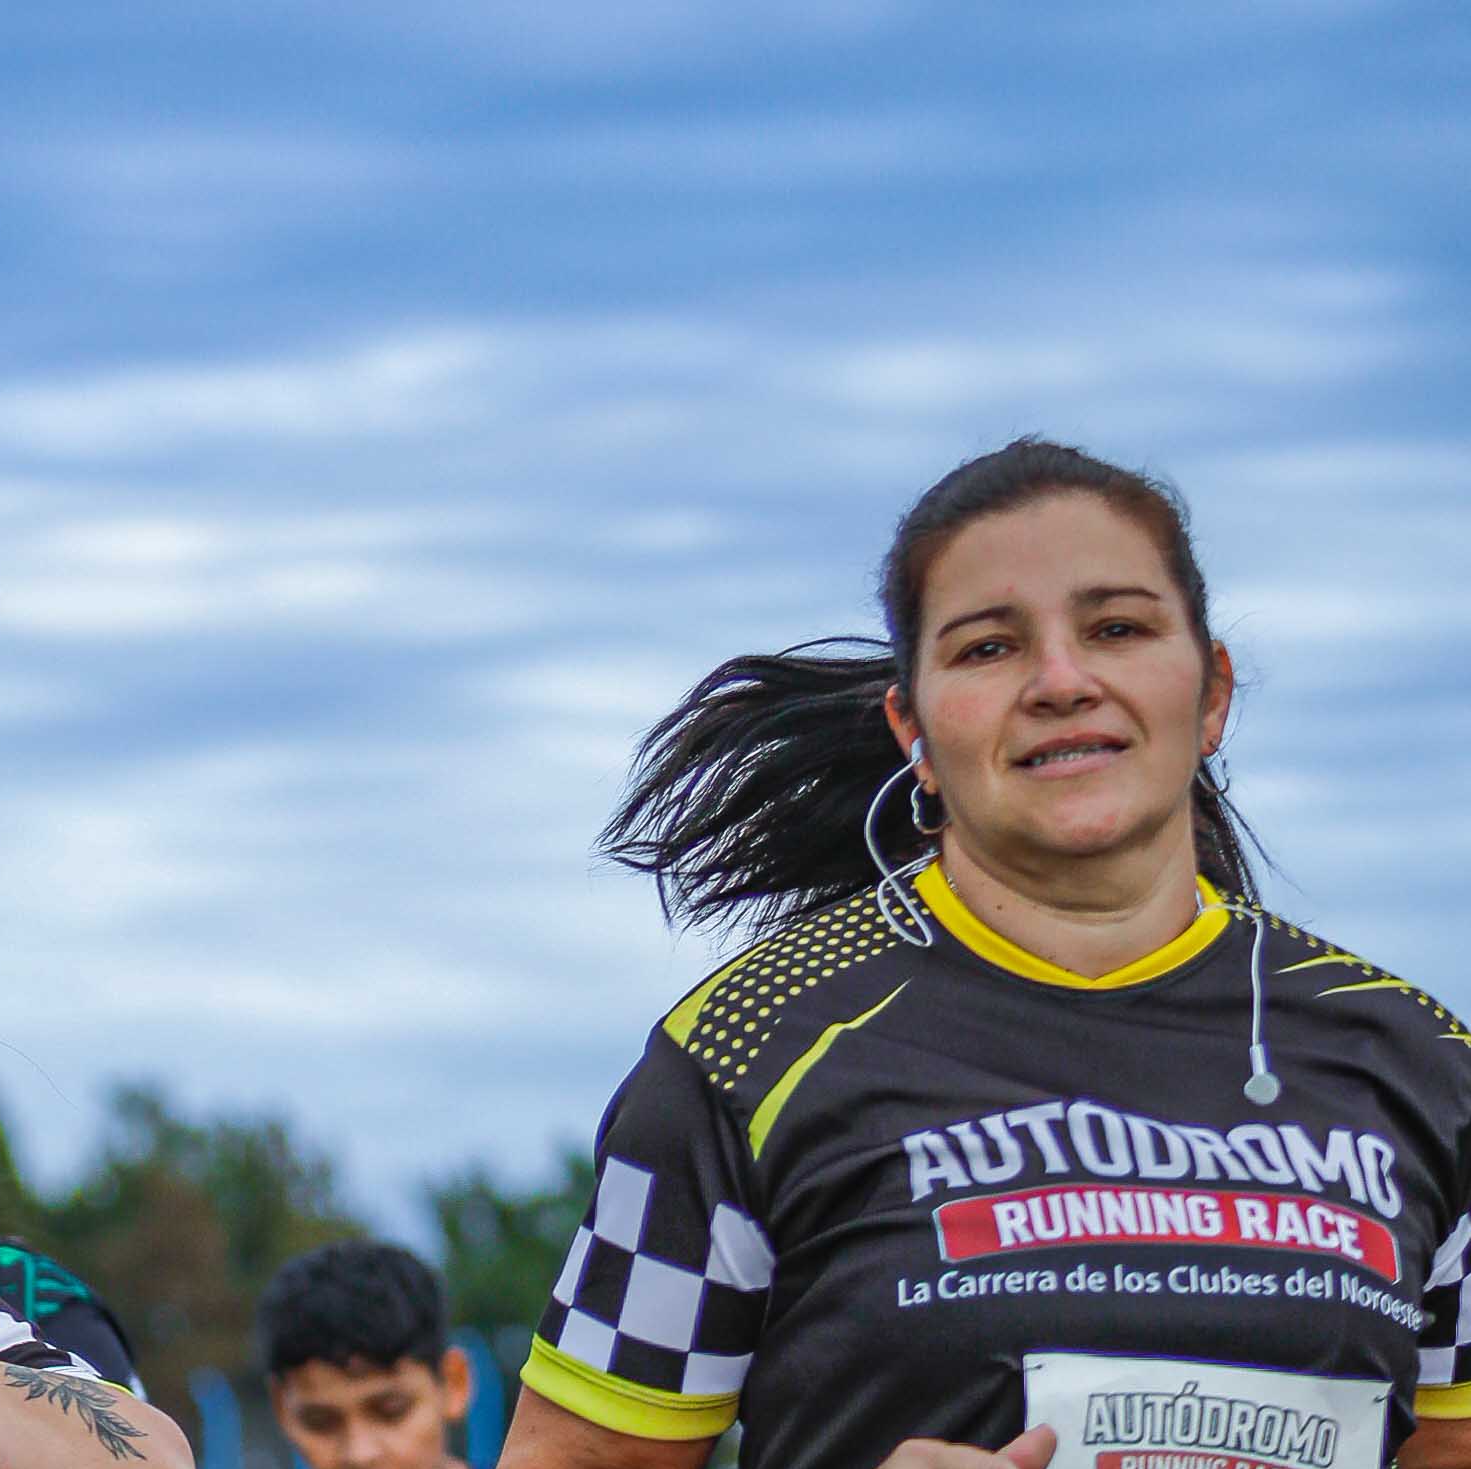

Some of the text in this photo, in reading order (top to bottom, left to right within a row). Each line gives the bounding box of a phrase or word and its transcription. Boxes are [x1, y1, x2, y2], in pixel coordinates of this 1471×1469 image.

[991, 1191, 1365, 1260] RUNNING RACE
[896, 1263, 1424, 1332] La Carrera de los Clubes del Noroeste
[1082, 1380, 1338, 1469] AUTÓDROMO
